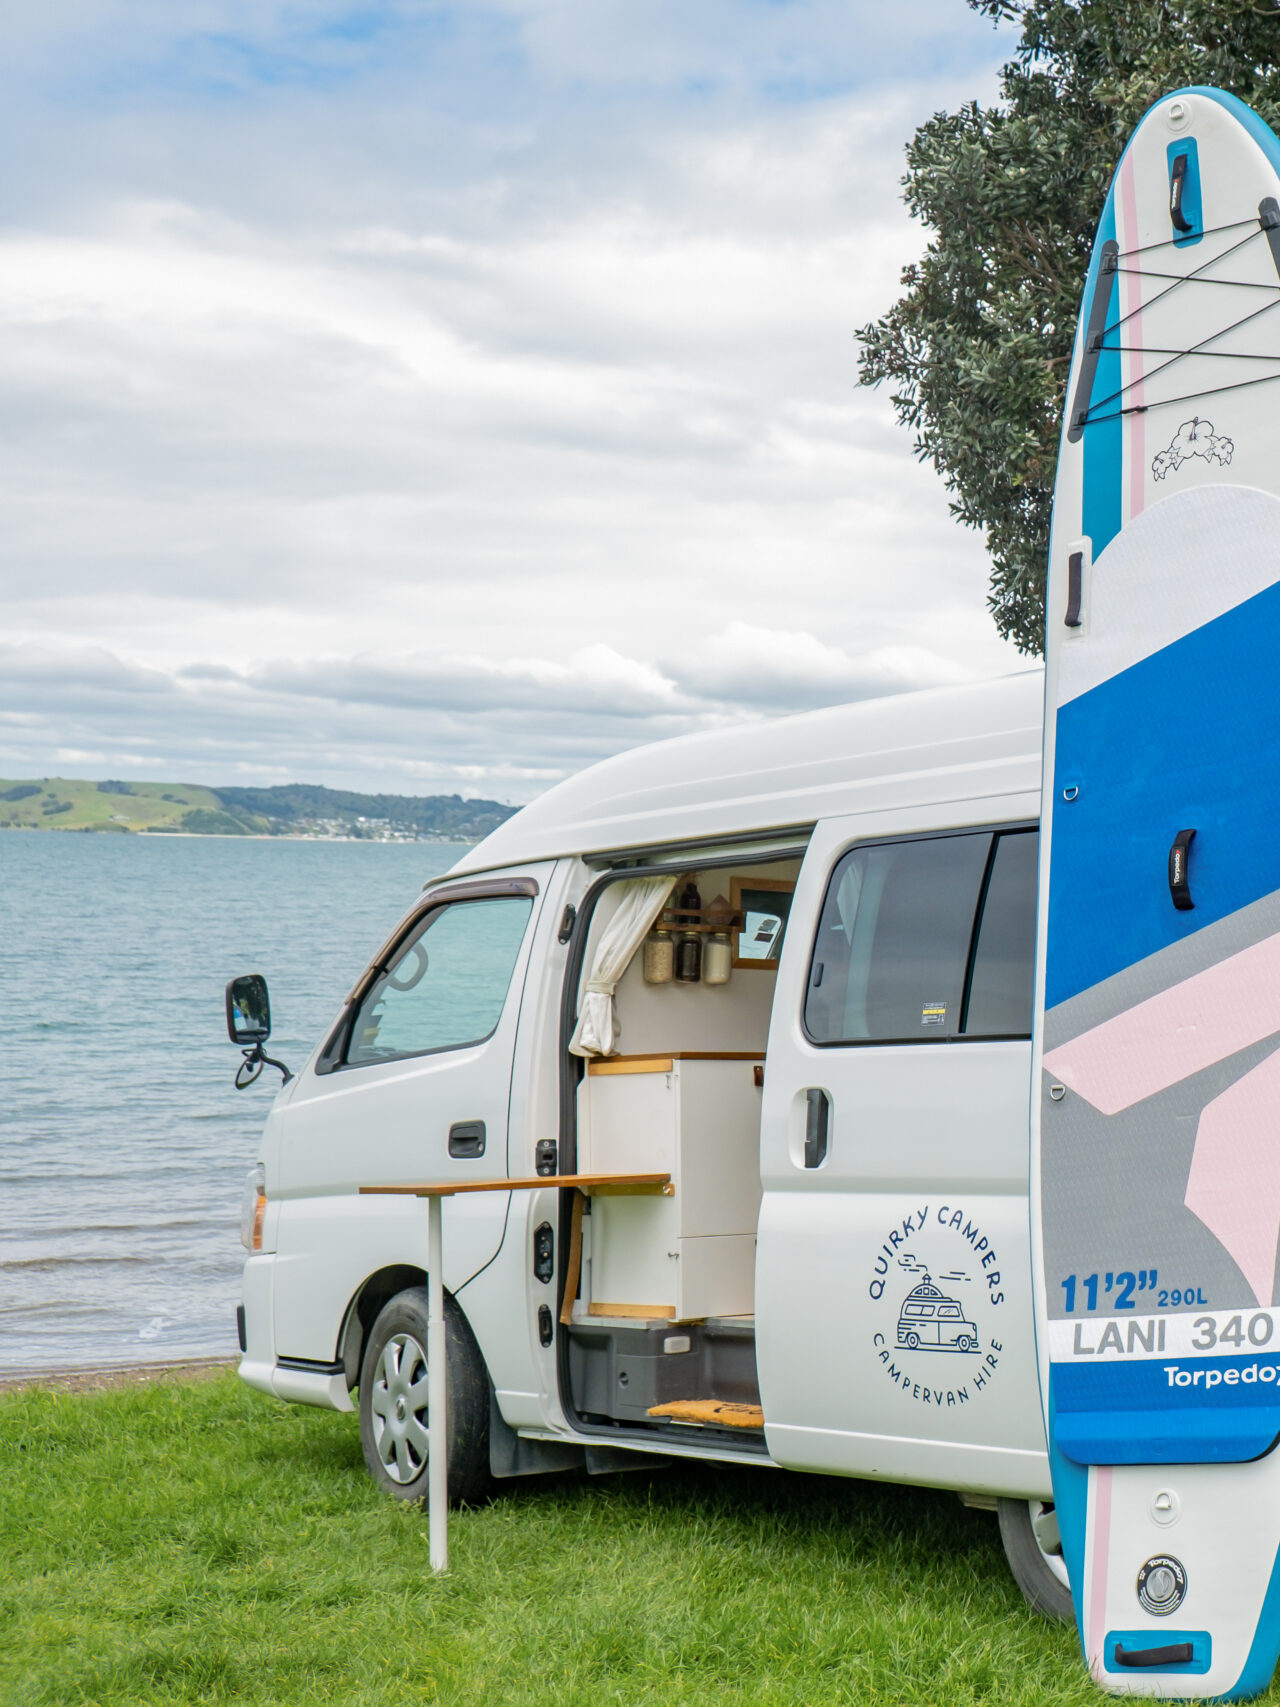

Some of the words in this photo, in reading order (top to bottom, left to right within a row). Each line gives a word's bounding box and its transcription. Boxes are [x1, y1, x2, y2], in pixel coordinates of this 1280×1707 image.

[869, 1205, 929, 1300] QUIRKY
[937, 1206, 1005, 1306] CAMPERS
[1157, 1287, 1208, 1307] 290L
[1072, 1319, 1166, 1356] LANI
[1191, 1312, 1275, 1351] 340
[873, 1332, 970, 1407] CAMPERVAN
[972, 1338, 1003, 1392] HIRE
